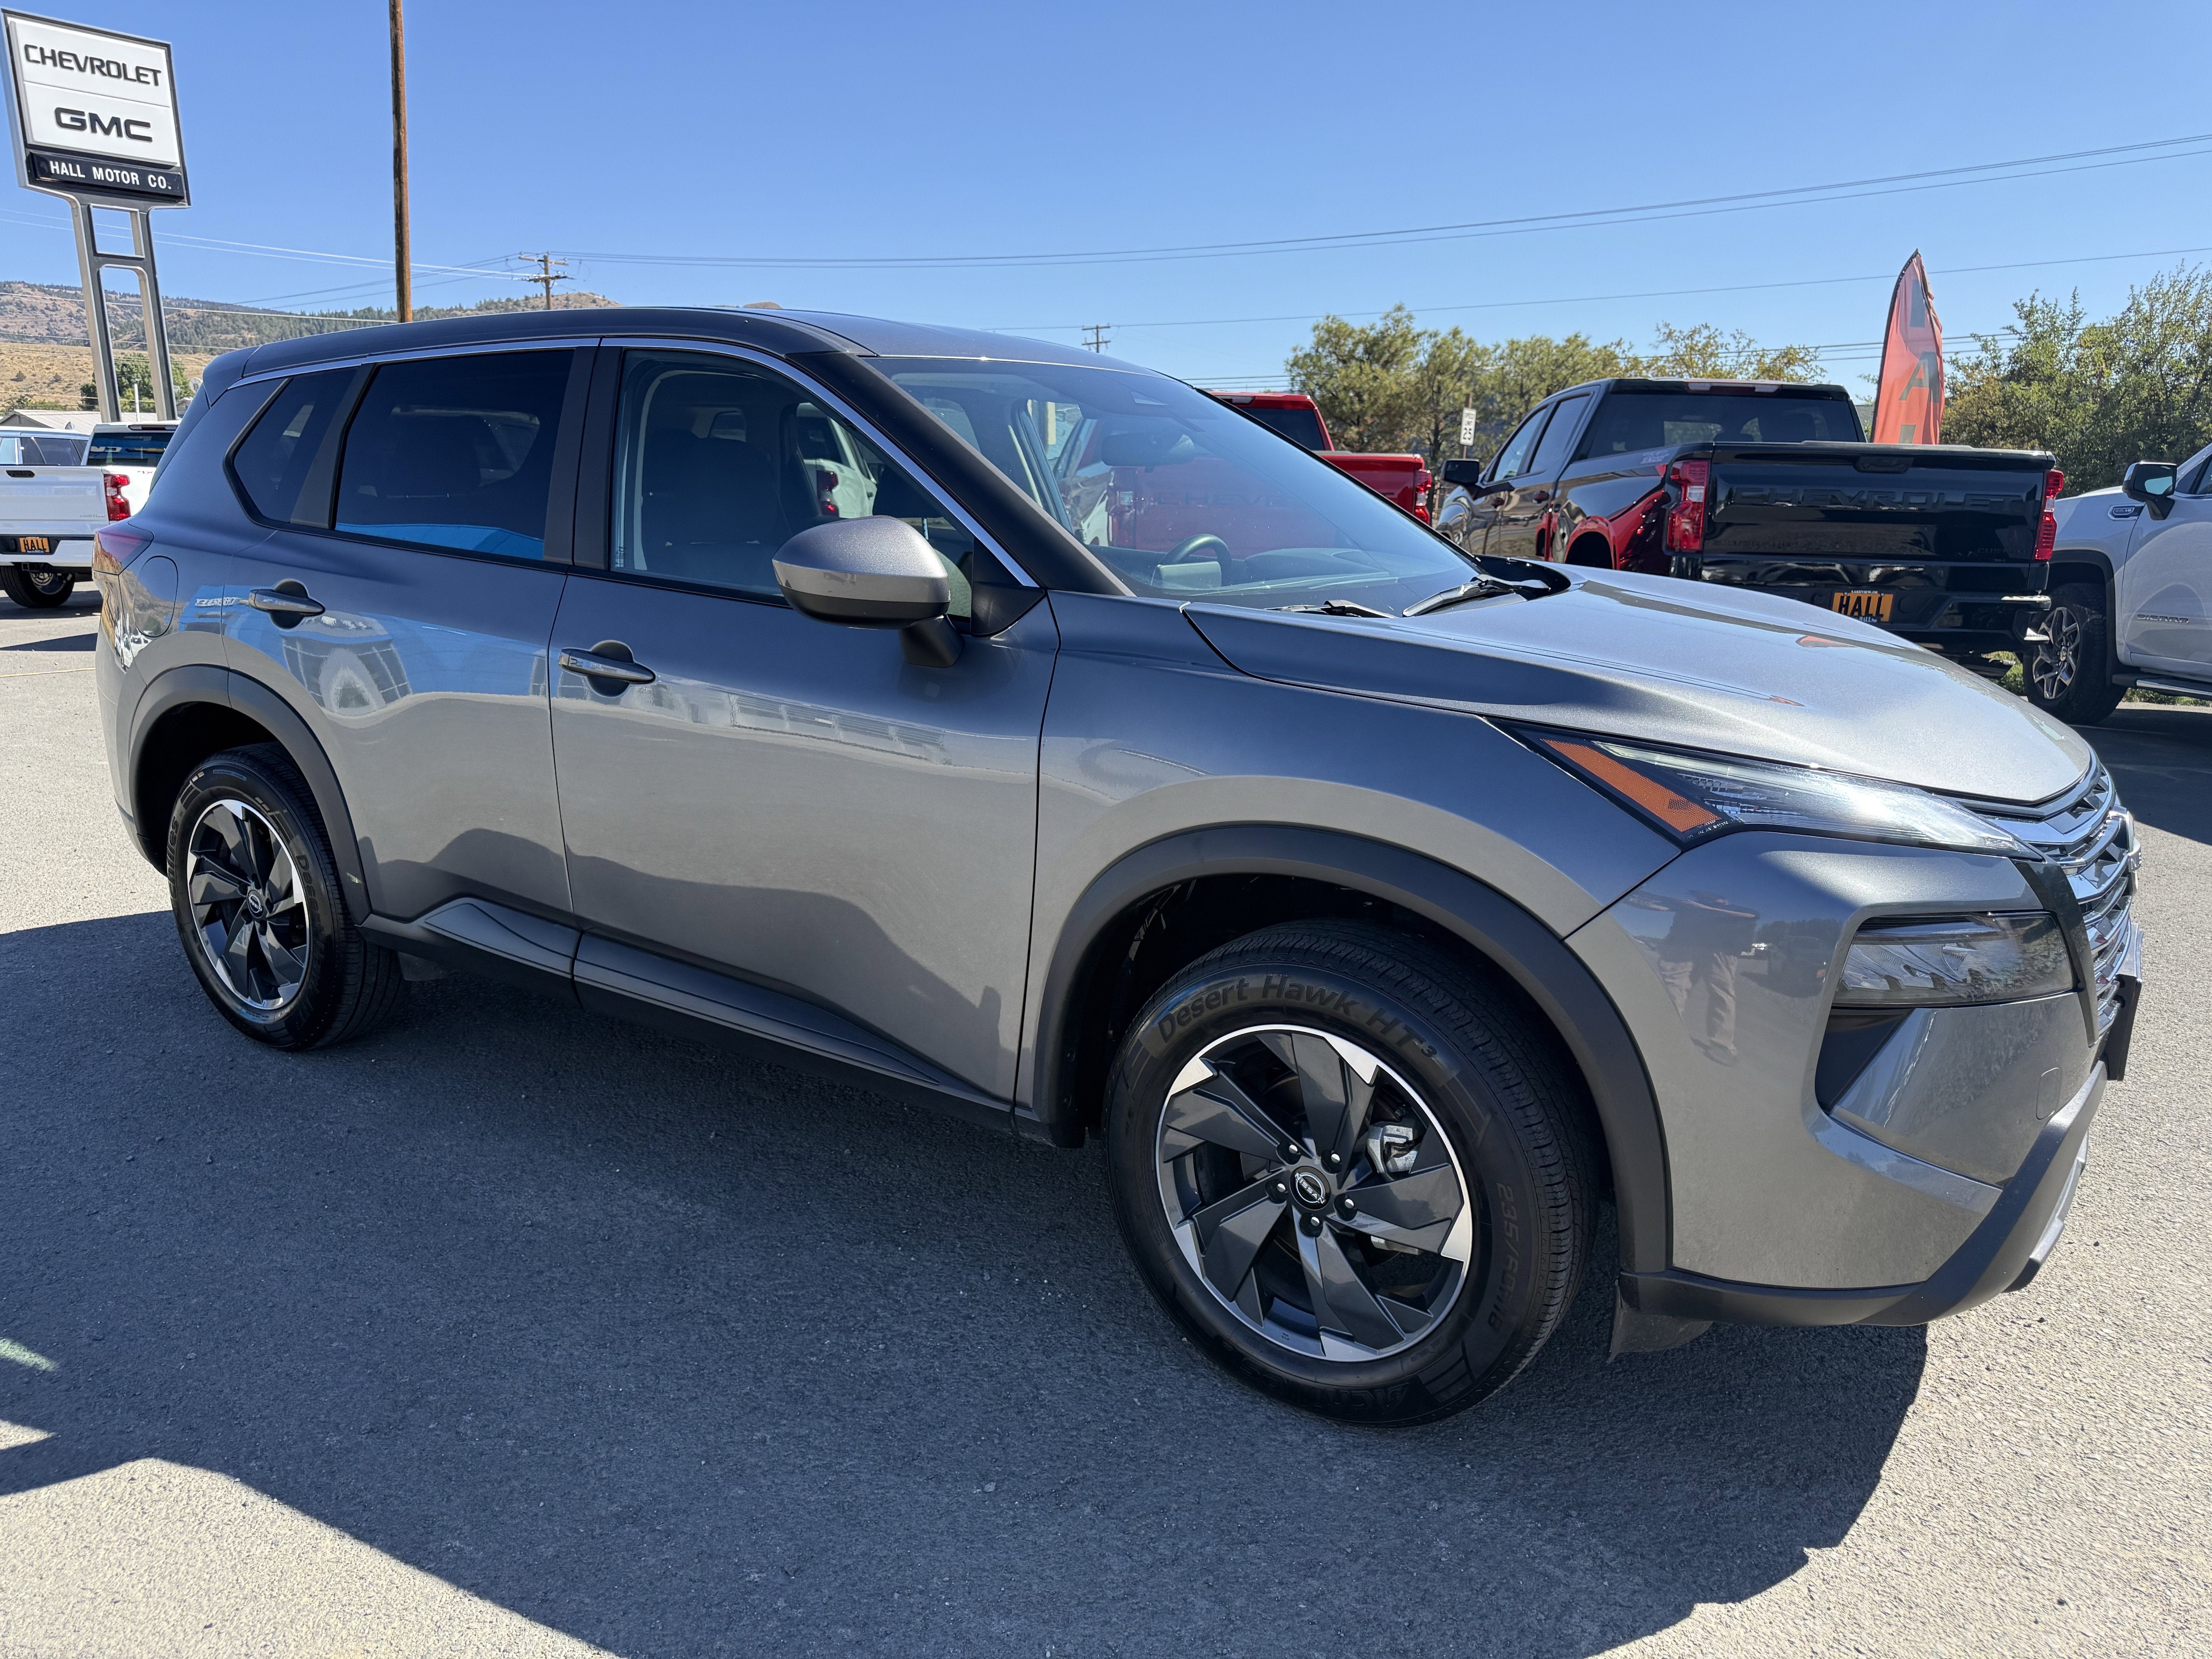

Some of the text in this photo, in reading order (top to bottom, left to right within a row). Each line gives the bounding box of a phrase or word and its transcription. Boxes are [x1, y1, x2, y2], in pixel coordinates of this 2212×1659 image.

[24, 44, 162, 87] CHEVROLET
[54, 106, 153, 143] GMC
[50, 160, 172, 190] HALL MOTOR CO.
[1463, 427, 1472, 441] 25
[1735, 487, 2023, 510] CHEVROLET
[23, 538, 47, 552] HALL
[1838, 595, 1884, 619] HALL
[1157, 977, 1250, 1044] Desert
[1261, 973, 1361, 1017] Hawk
[1295, 1172, 1325, 1204] NISSAN
